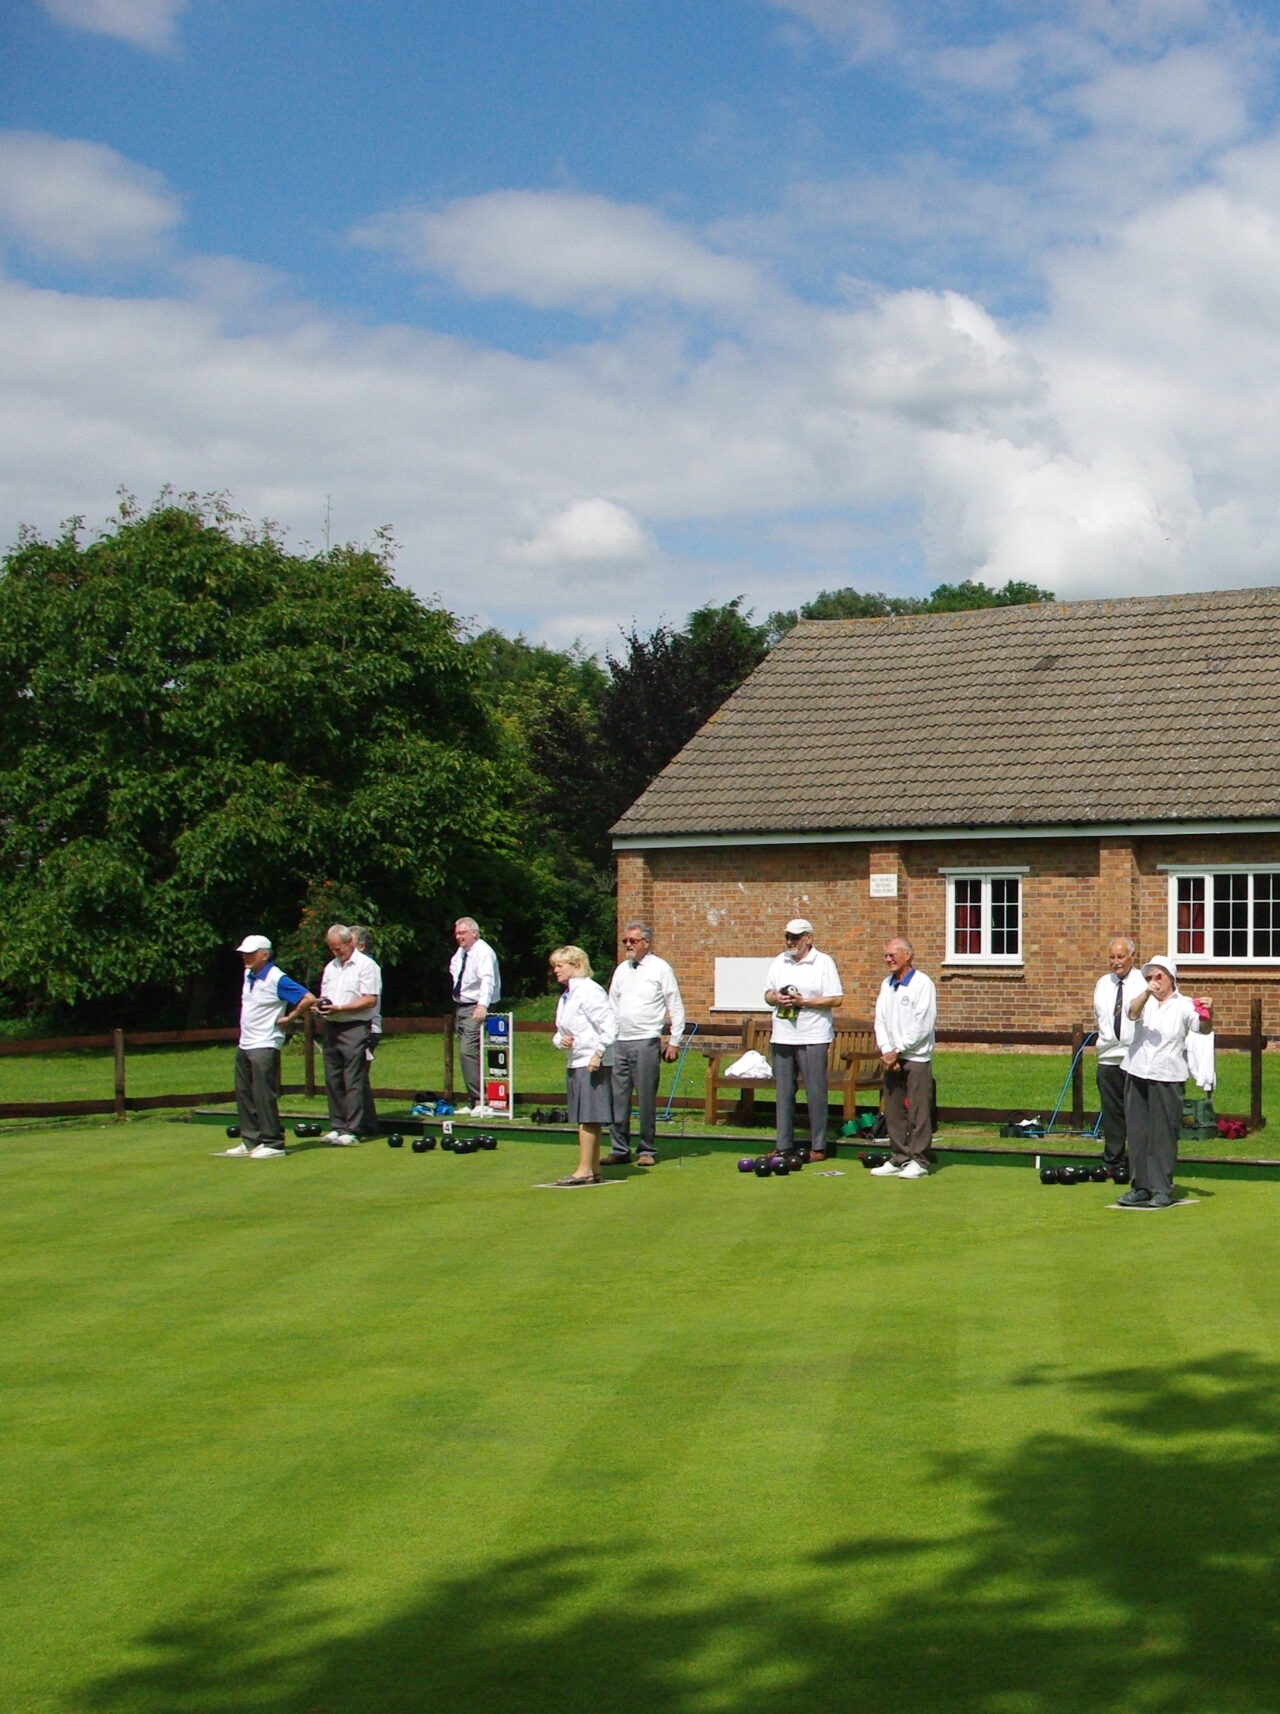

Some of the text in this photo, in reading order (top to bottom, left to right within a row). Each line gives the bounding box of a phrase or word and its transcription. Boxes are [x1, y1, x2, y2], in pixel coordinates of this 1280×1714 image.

[498, 1020, 505, 1032] 0
[498, 1053, 505, 1064] 0
[498, 1085, 505, 1096] 0
[445, 1123, 450, 1131] 4
